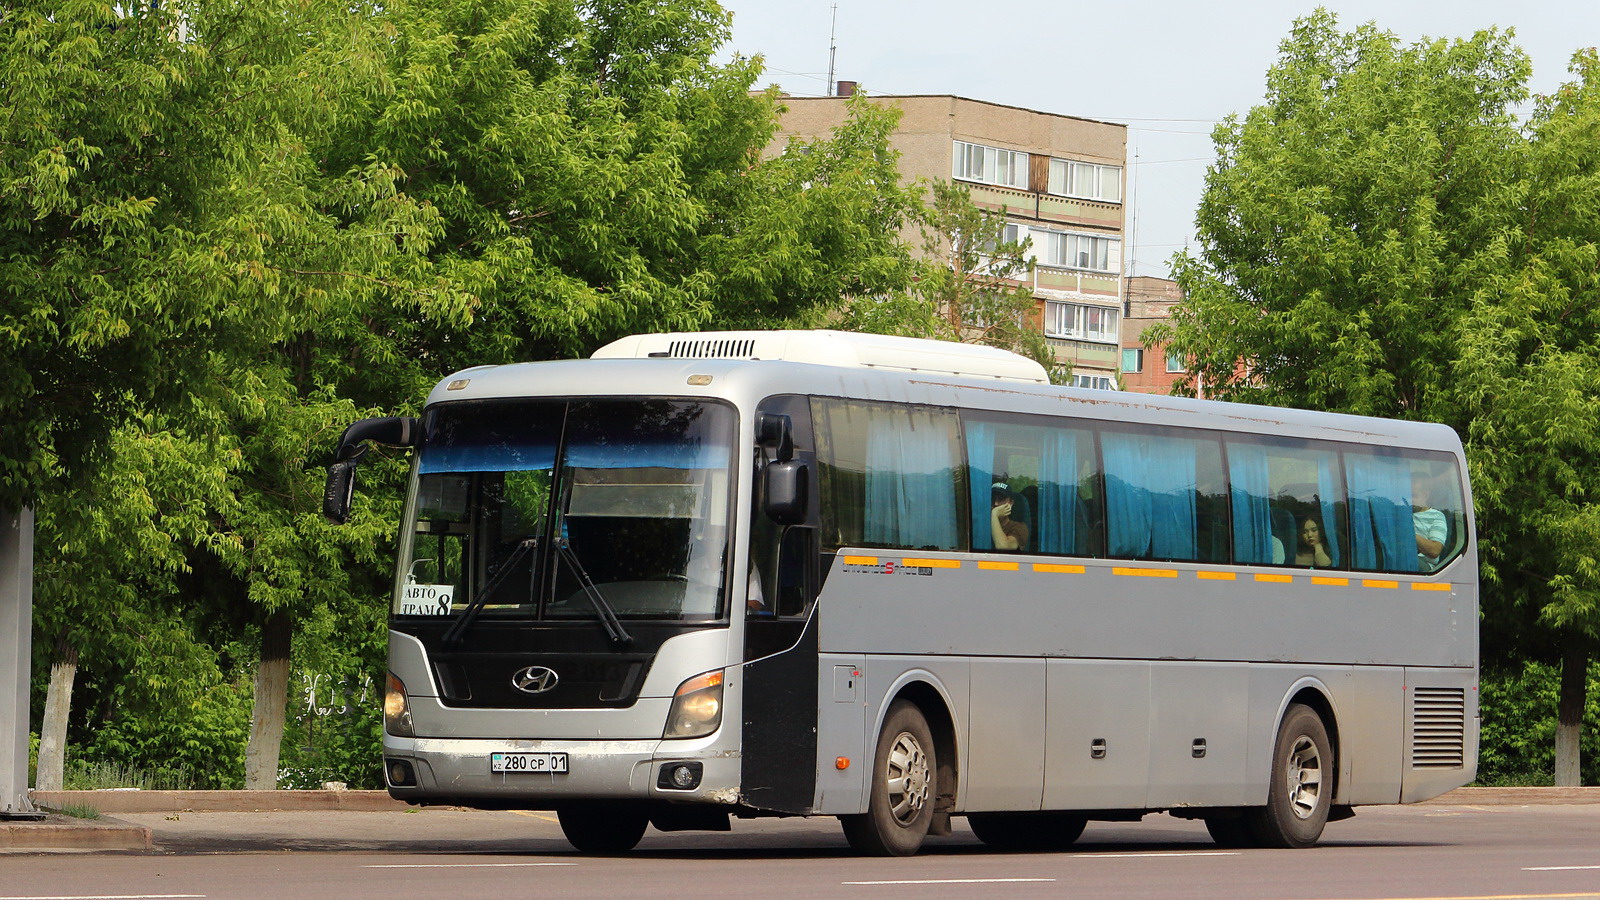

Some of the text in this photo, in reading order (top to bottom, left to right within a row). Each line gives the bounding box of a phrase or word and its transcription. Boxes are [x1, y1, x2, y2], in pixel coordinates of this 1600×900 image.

[405, 588, 436, 599] АВТО
[403, 594, 450, 615] ТРАМ 8
[505, 756, 526, 769] 280
[551, 756, 565, 769] 01
